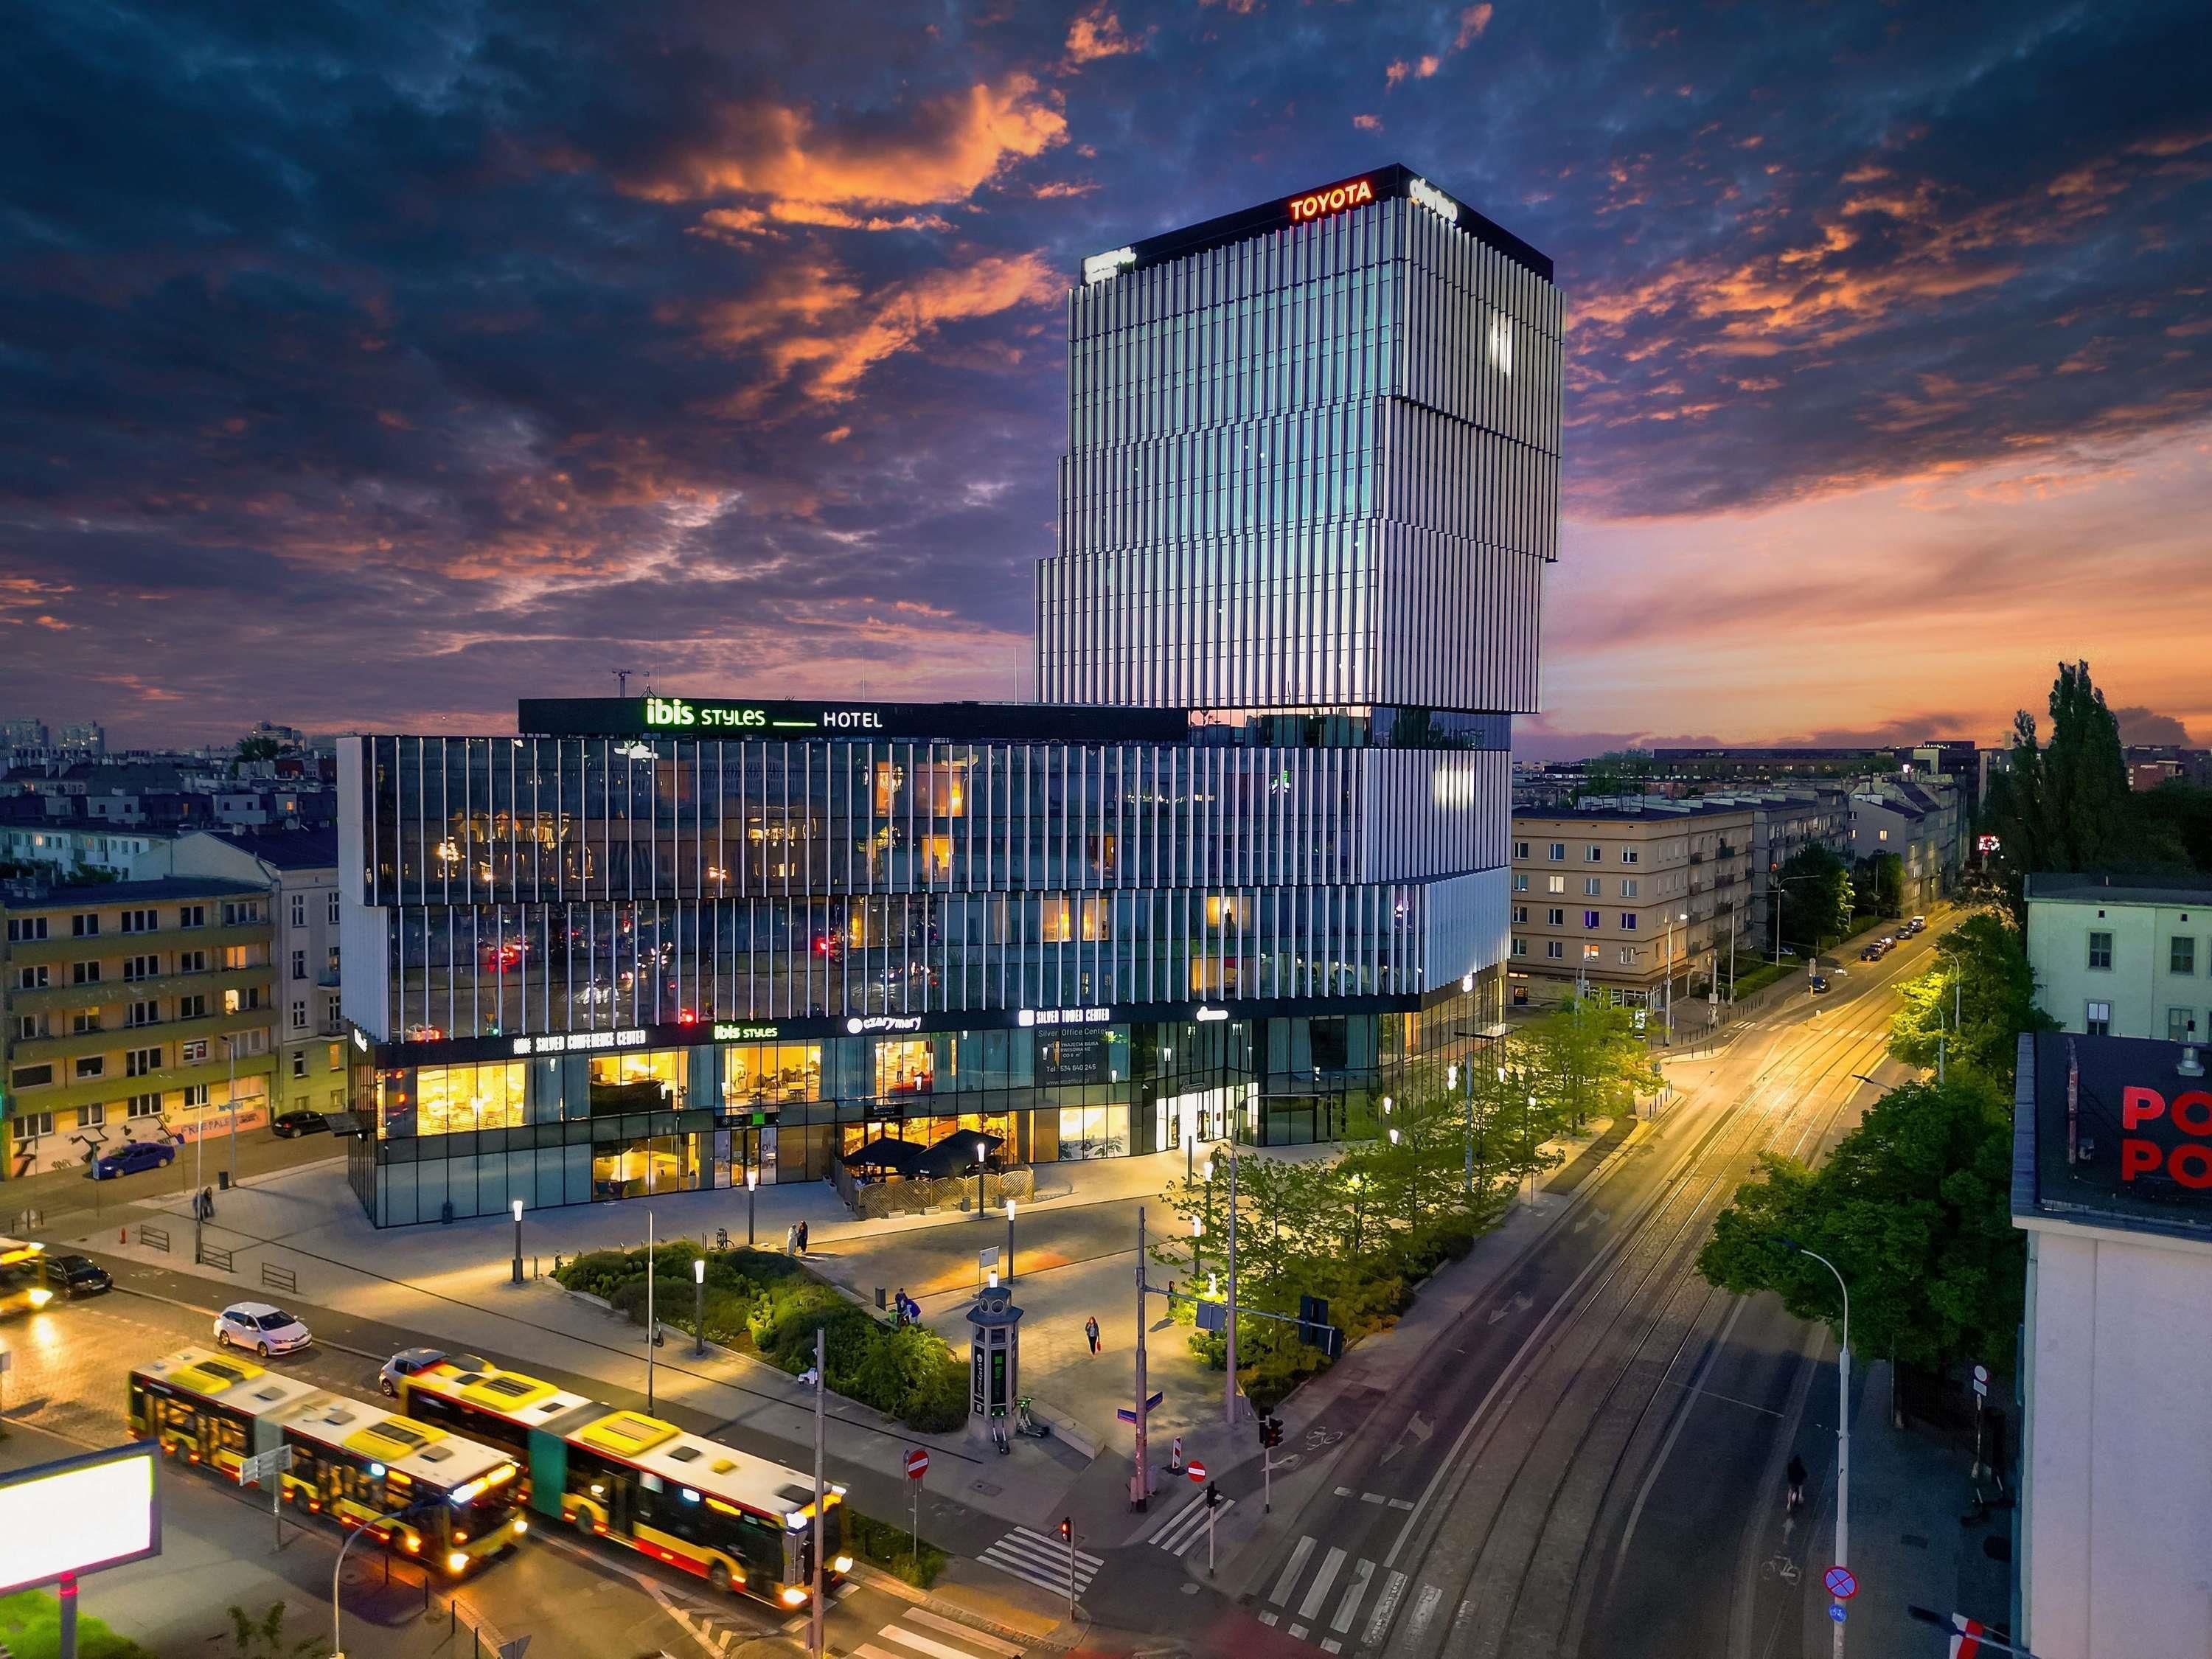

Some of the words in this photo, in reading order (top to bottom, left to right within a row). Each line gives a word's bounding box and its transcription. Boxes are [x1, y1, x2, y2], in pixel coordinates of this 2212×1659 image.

[1290, 181, 1372, 220] TOYOTA
[647, 698, 695, 726] ibis
[824, 712, 883, 728] HOTEL
[1036, 1010, 1060, 1024] SILVER
[1062, 1009, 1084, 1023] TOWER
[1085, 1008, 1110, 1022] CENTER
[536, 1036, 565, 1052] SILVER
[616, 1030, 646, 1046] CENTER
[714, 1025, 740, 1040] ibis
